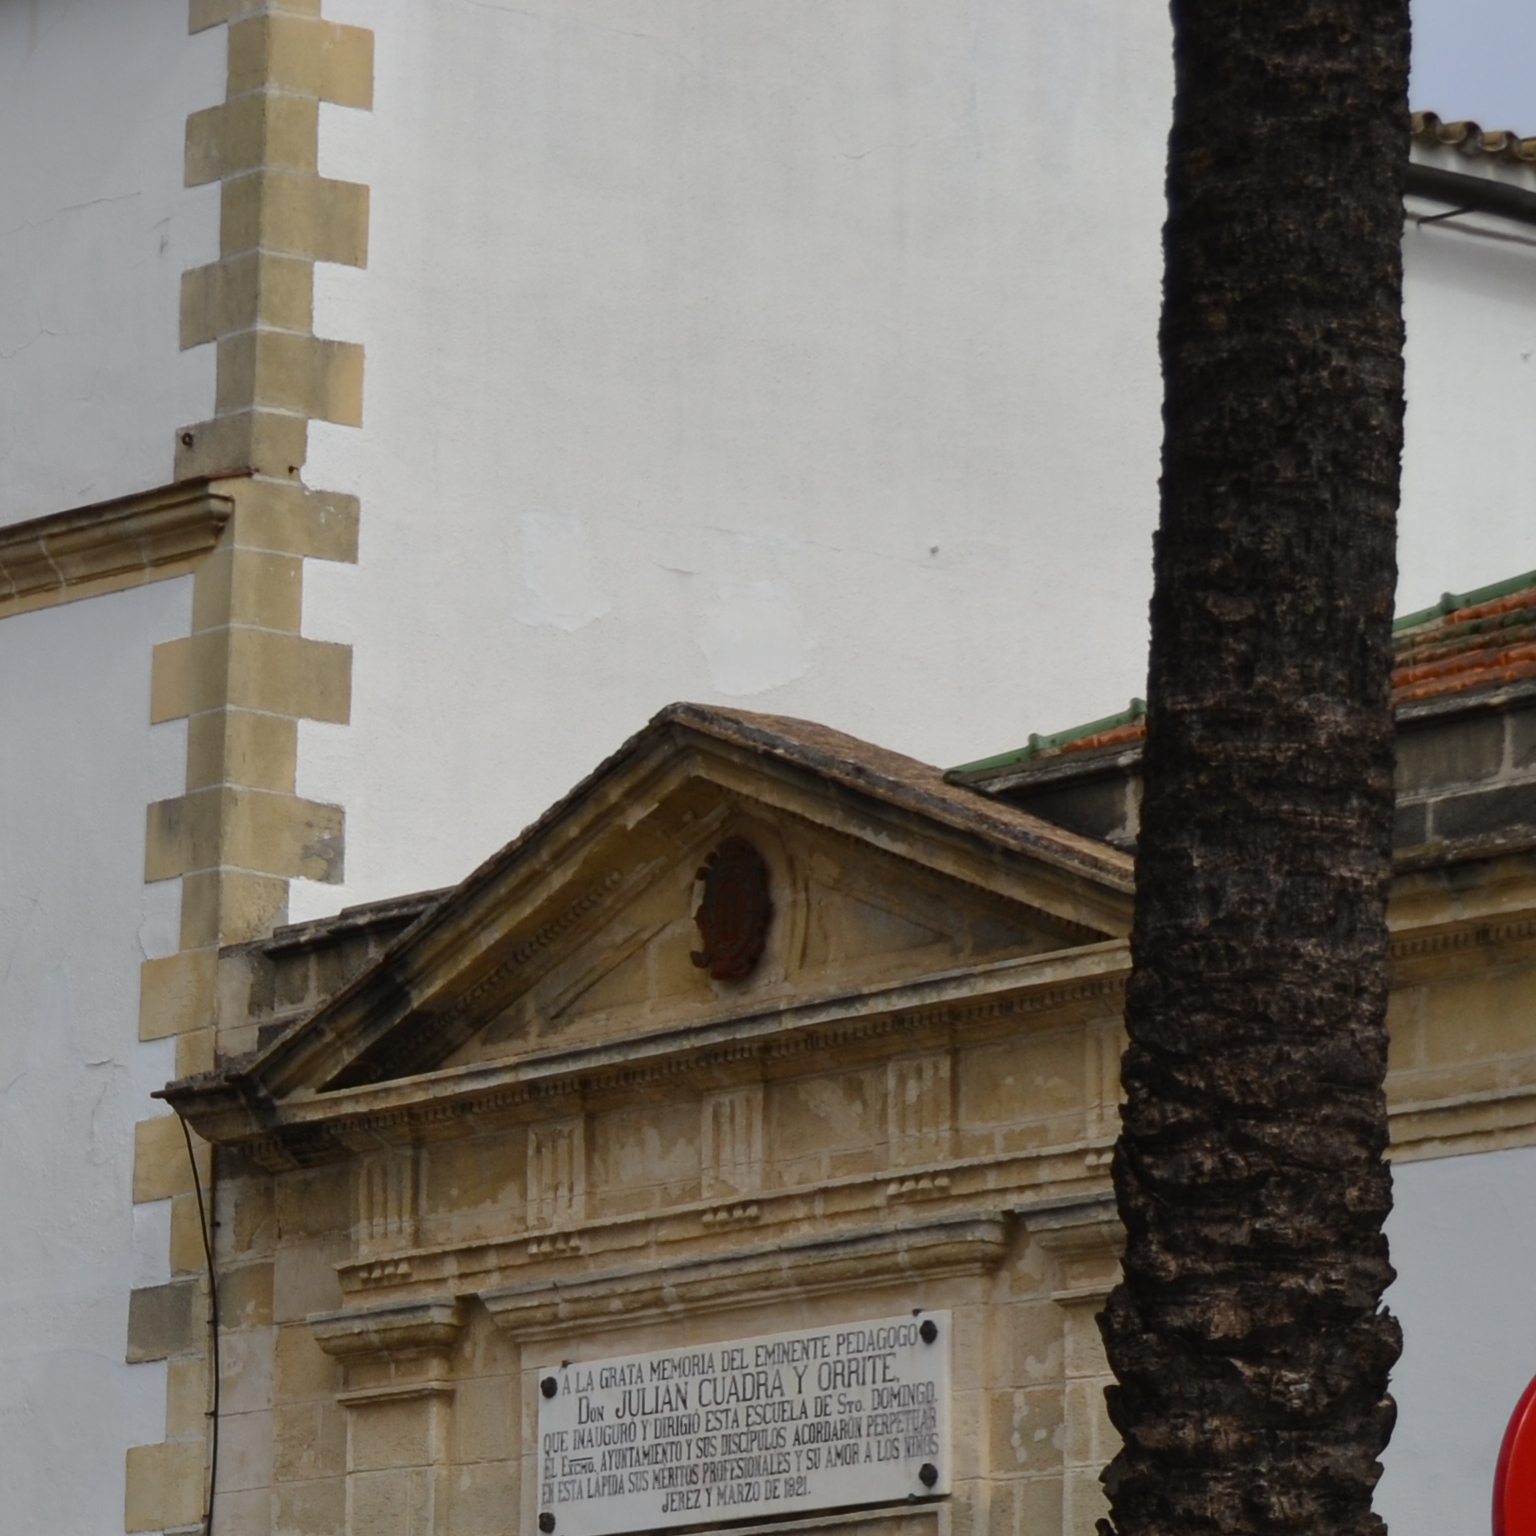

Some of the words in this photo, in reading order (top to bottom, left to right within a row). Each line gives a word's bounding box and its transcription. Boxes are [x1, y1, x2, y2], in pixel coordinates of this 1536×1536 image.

[562, 1374, 571, 1396] A
[575, 1371, 595, 1394] LA
[599, 1363, 644, 1390] GRATA
[649, 1352, 715, 1382] MEMORIA
[721, 1347, 749, 1372] DEL
[755, 1335, 831, 1368] EMINENTE
[836, 1323, 918, 1356] PEDAGOGO
[615, 1381, 689, 1419] JULIÁN
[698, 1368, 785, 1408] CUADRA
[793, 1364, 808, 1395] Y
[818, 1352, 901, 1391] ORRITE,
[543, 1431, 569, 1456] QUE
[573, 1417, 637, 1450] INAUGURÓ
[641, 1420, 652, 1442] Y
[654, 1409, 700, 1440] DIRIGIÓ
[705, 1407, 740, 1433] ESTA
[745, 1400, 808, 1428] ESCUELA
[814, 1395, 832, 1418] DE
[871, 1381, 938, 1412] DOMINGO.
[544, 1457, 557, 1480] EL
[600, 1440, 682, 1473] AYUNTAMIENTO
[686, 1438, 694, 1460] Y
[696, 1435, 718, 1459] SUS
[792, 1415, 863, 1447] ACORDARON
[866, 1406, 937, 1438] PERPETUAR
[542, 1482, 555, 1505] EN
[558, 1479, 583, 1503] ESTA
[587, 1471, 625, 1499] LÁPIDA
[628, 1470, 649, 1493] SUS
[652, 1463, 699, 1490] MÉRITOS
[702, 1450, 790, 1484] PROFESIONALES
[795, 1450, 803, 1472] Y
[806, 1447, 821, 1470] SU
[825, 1442, 859, 1468] AMOR
[864, 1440, 872, 1463] A
[877, 1437, 900, 1462] LOS
[662, 1490, 701, 1514] JEREZ
[705, 1487, 713, 1508] Y
[716, 1479, 760, 1507] MARZO
[764, 1477, 780, 1500] DE
